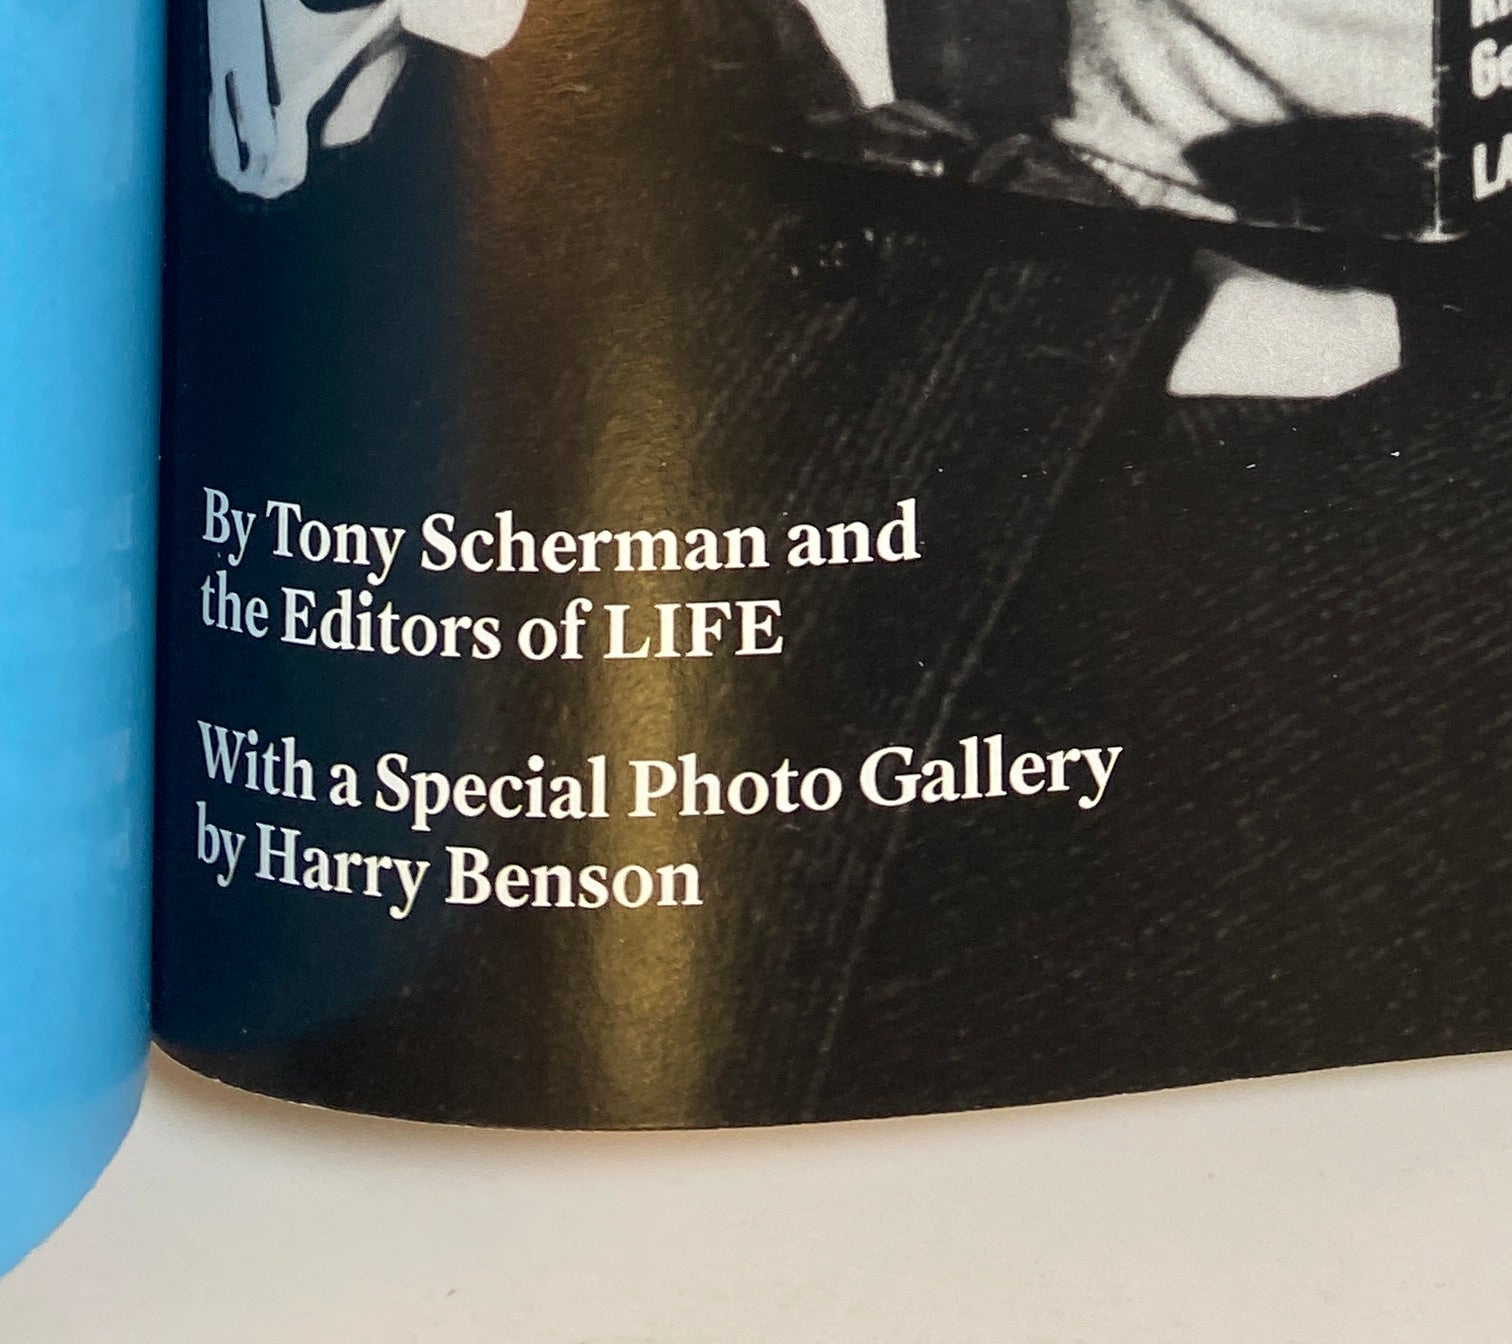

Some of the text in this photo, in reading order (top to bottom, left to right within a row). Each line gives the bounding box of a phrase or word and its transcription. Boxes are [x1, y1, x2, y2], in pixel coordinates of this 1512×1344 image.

[202, 487, 922, 584] By Tony Scherman and
[201, 573, 784, 661] the Editors of LIFE
[198, 721, 1123, 832] With a Special Photo Gallery
[196, 802, 702, 919] by Harry Benson
